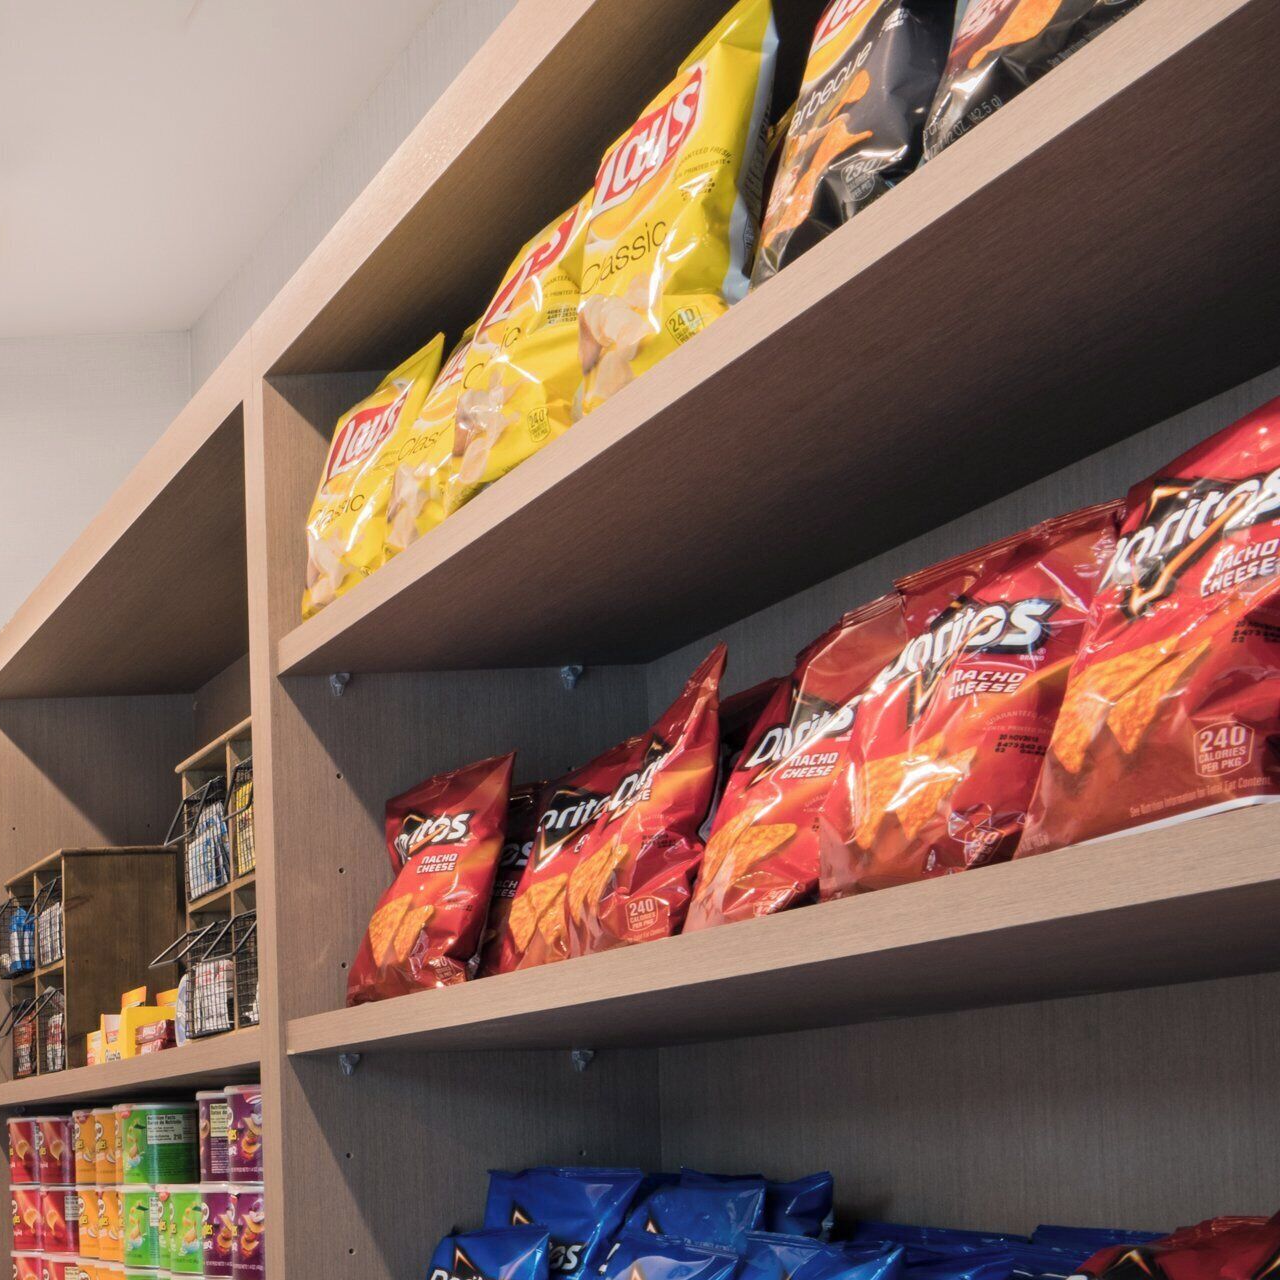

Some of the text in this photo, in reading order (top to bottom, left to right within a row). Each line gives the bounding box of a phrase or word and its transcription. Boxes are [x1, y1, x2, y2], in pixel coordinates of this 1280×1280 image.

[788, 41, 873, 137] arbecue
[580, 219, 668, 297] Classic
[1212, 539, 1280, 577] NACHO
[1200, 557, 1280, 598] CHEESE
[953, 669, 1027, 685] NACHO
[946, 681, 1020, 701] CHEESE
[1200, 726, 1246, 752] 240
[790, 753, 839, 768] NACHO
[1199, 746, 1246, 763] CALORIES
[780, 765, 835, 780] CHEESE
[1202, 757, 1242, 773] PER PKG
[395, 812, 471, 855] ritos
[421, 853, 459, 863] NACHO
[416, 862, 457, 874] CHEESE
[629, 899, 654, 917] 240
